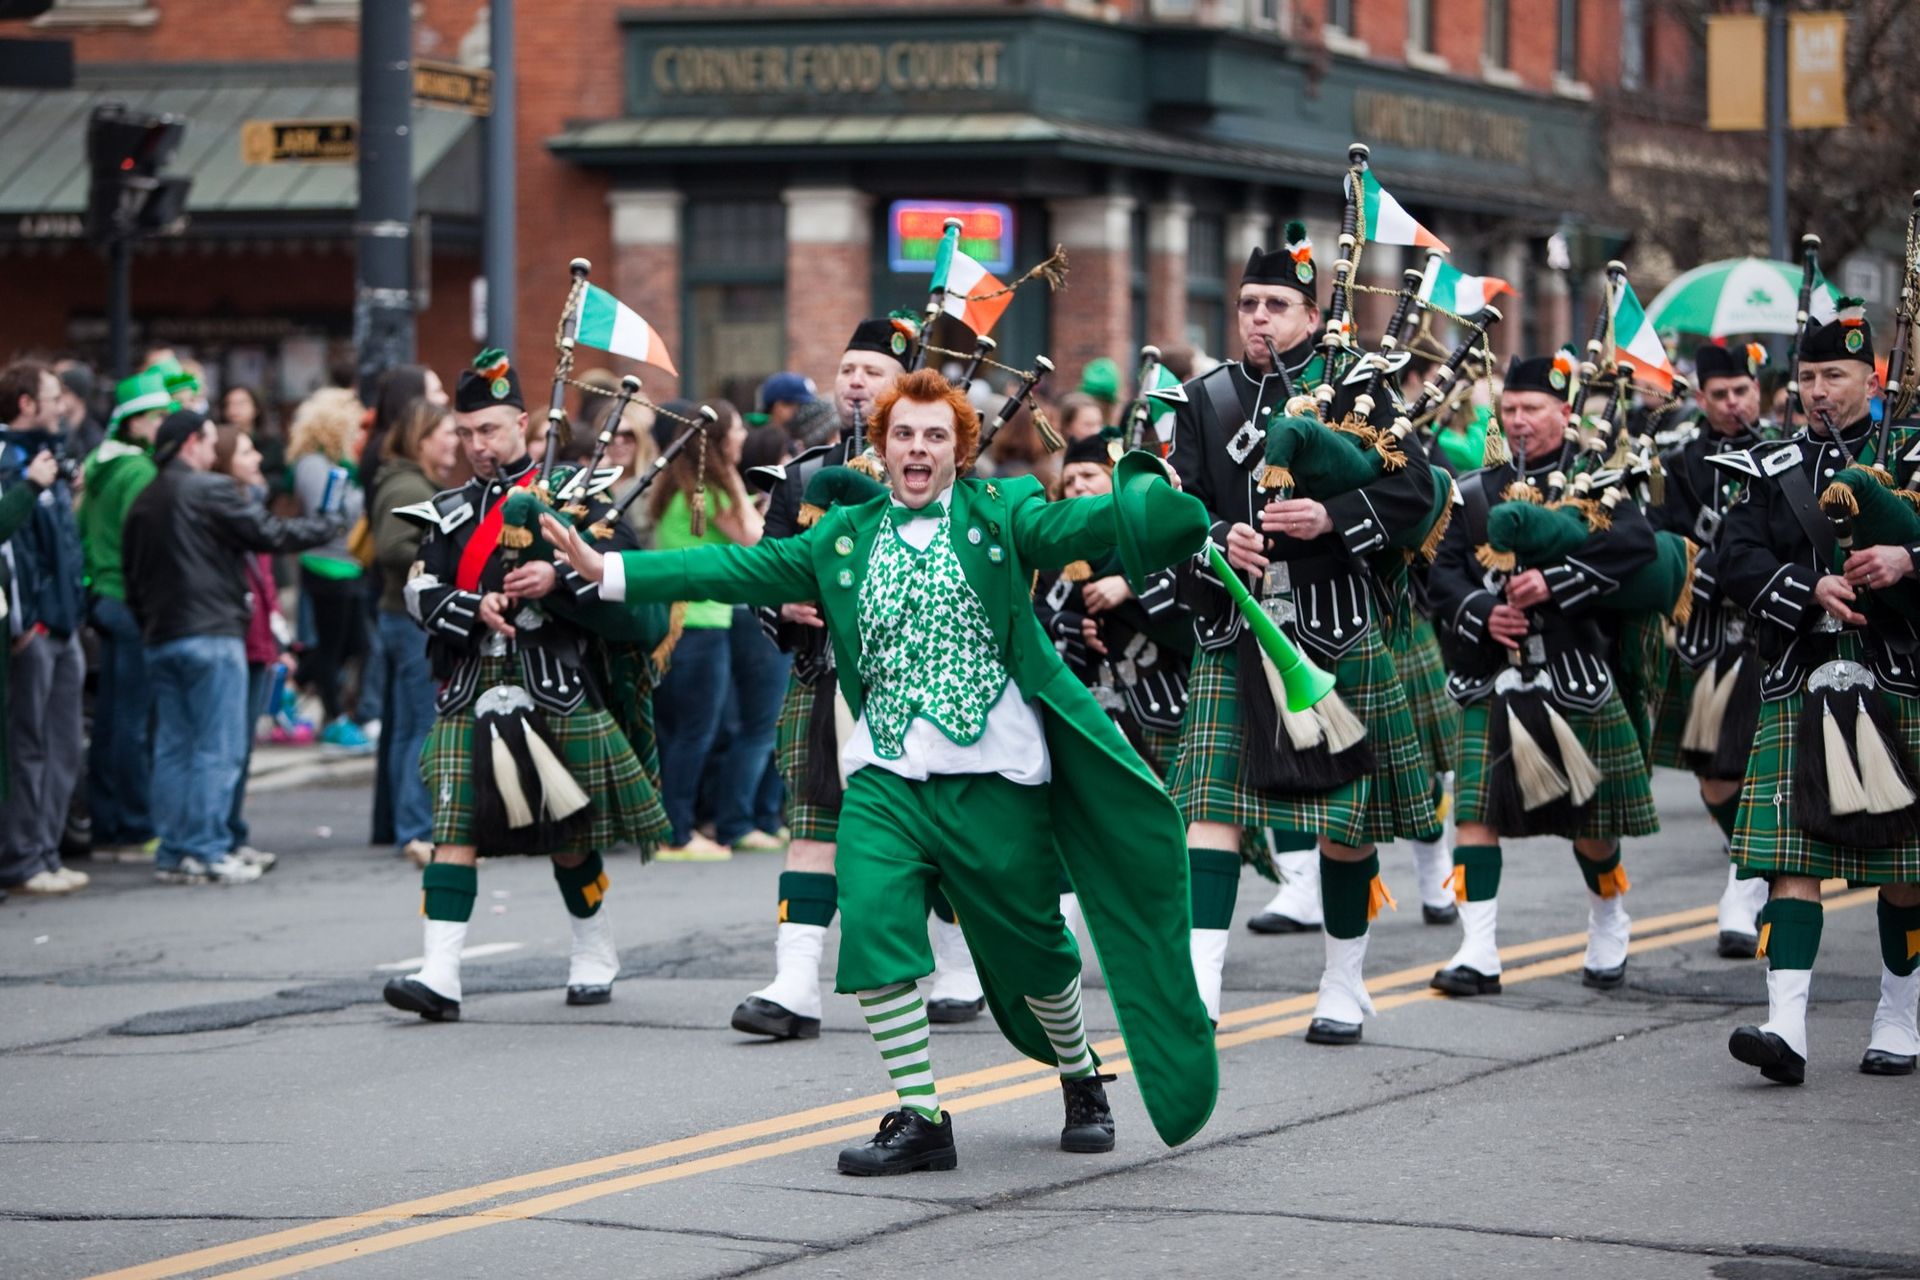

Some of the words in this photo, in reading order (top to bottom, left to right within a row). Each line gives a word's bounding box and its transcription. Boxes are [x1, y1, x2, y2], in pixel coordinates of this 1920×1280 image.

[652, 44, 788, 94] CORNER
[792, 42, 882, 92] FOOD
[886, 40, 1003, 90] COURT
